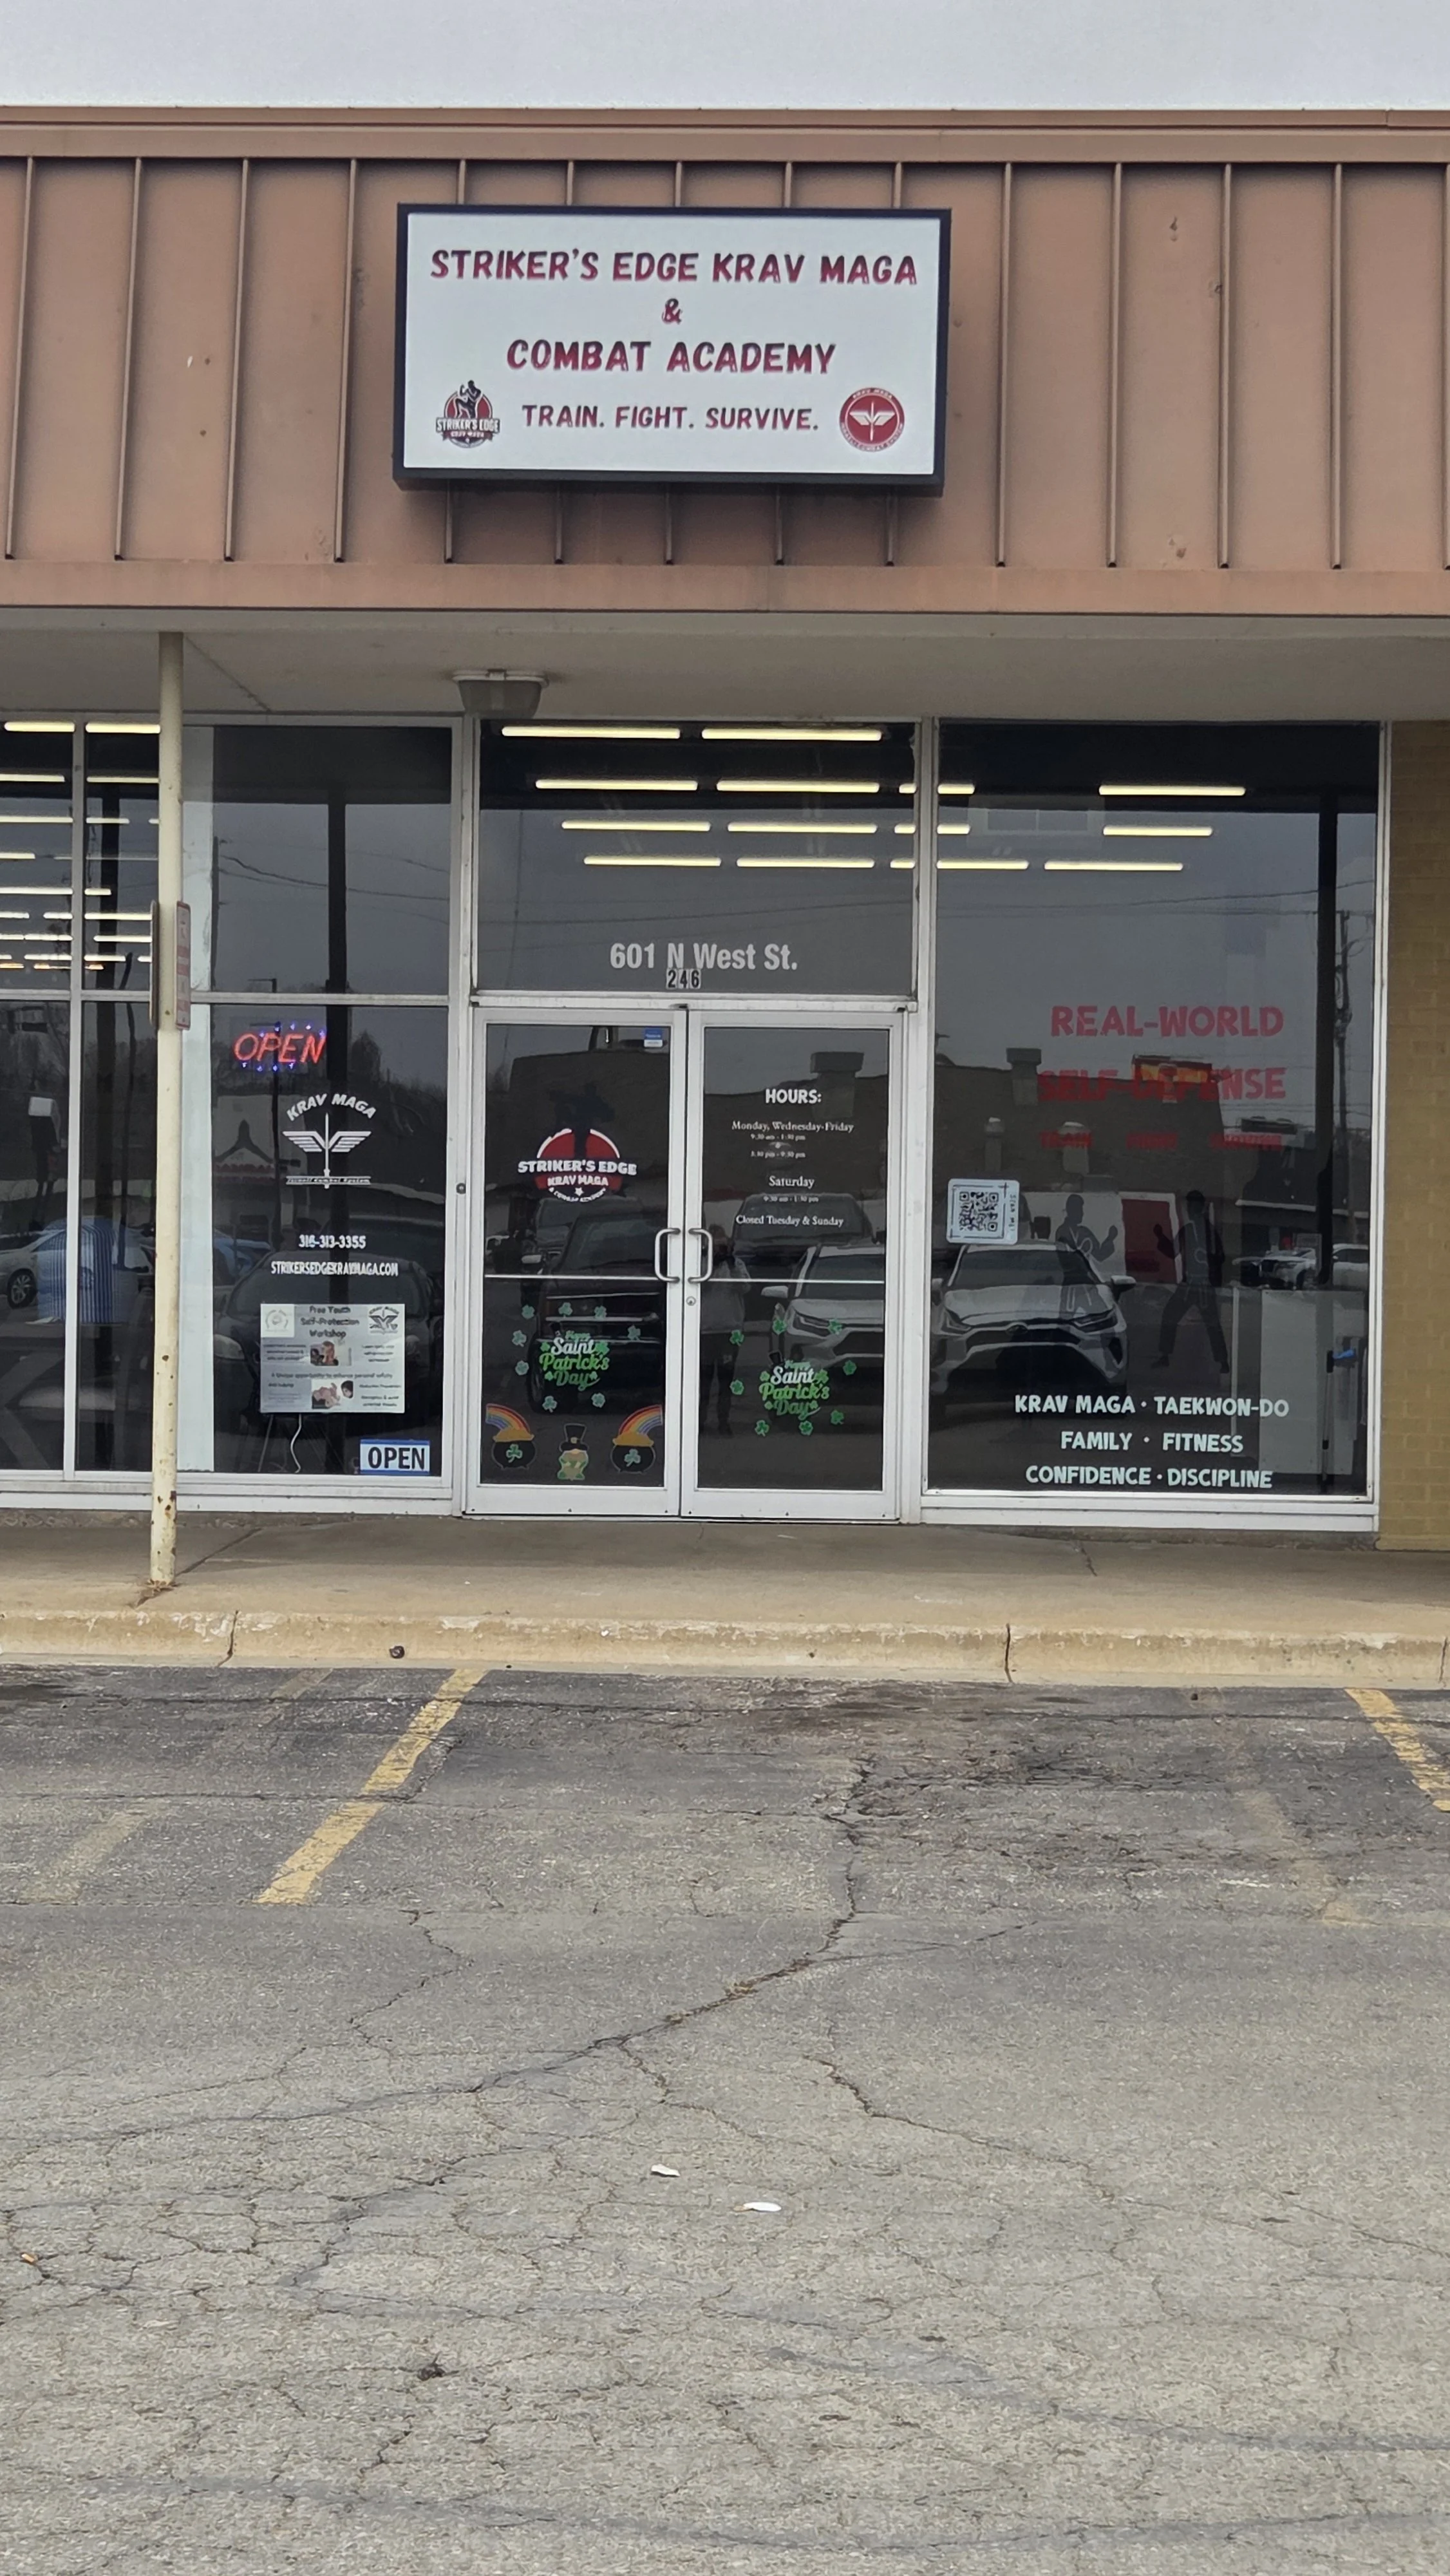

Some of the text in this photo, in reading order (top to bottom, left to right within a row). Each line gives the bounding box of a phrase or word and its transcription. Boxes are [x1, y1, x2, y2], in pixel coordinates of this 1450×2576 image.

[430, 248, 917, 285] STRIKER'S EDGE KRAV MAGA
[662, 298, 683, 324] &
[507, 339, 836, 374] COMBAT ACADEMY
[522, 404, 818, 430] TRAIN. FIGHT. SURVIVE.
[610, 943, 798, 970] 601 N West St.
[667, 969, 700, 989] 246
[1051, 1005, 1285, 1037] REAL-WORLD
[234, 1032, 326, 1064] OPEN
[1036, 1066, 1286, 1102] SELF-DEFENSE
[765, 1088, 822, 1104] HOURS:
[287, 1094, 376, 1121] KRAV MAGA
[731, 1121, 854, 1133] Monday, Wednesday-Friday
[518, 1160, 637, 1176] STRIKER'S EDGE
[547, 1175, 609, 1186] KRAV MAGA
[769, 1175, 815, 1189] Saturday
[736, 1215, 764, 1224] Closed
[766, 1215, 801, 1227] Tuesday
[812, 1216, 843, 1227] Sunday
[270, 1260, 399, 1277] STRIKERSEDGEKRAVMAGA.COM
[309, 1329, 347, 1338] Workshop
[551, 1337, 596, 1356] Saint
[539, 1353, 610, 1372] Patrick's
[554, 1370, 601, 1392] Day
[770, 1366, 814, 1385] Saint
[758, 1382, 830, 1401] Patrick's
[773, 1400, 822, 1421] Day
[1015, 1395, 1289, 1417] KRAV MAGA TAEKWON-DO
[1061, 1431, 1244, 1453] FAMILY FITNESS
[368, 1446, 425, 1470] OPEN
[1026, 1465, 1273, 1488] CONFIDENCE DISCIPLINE
